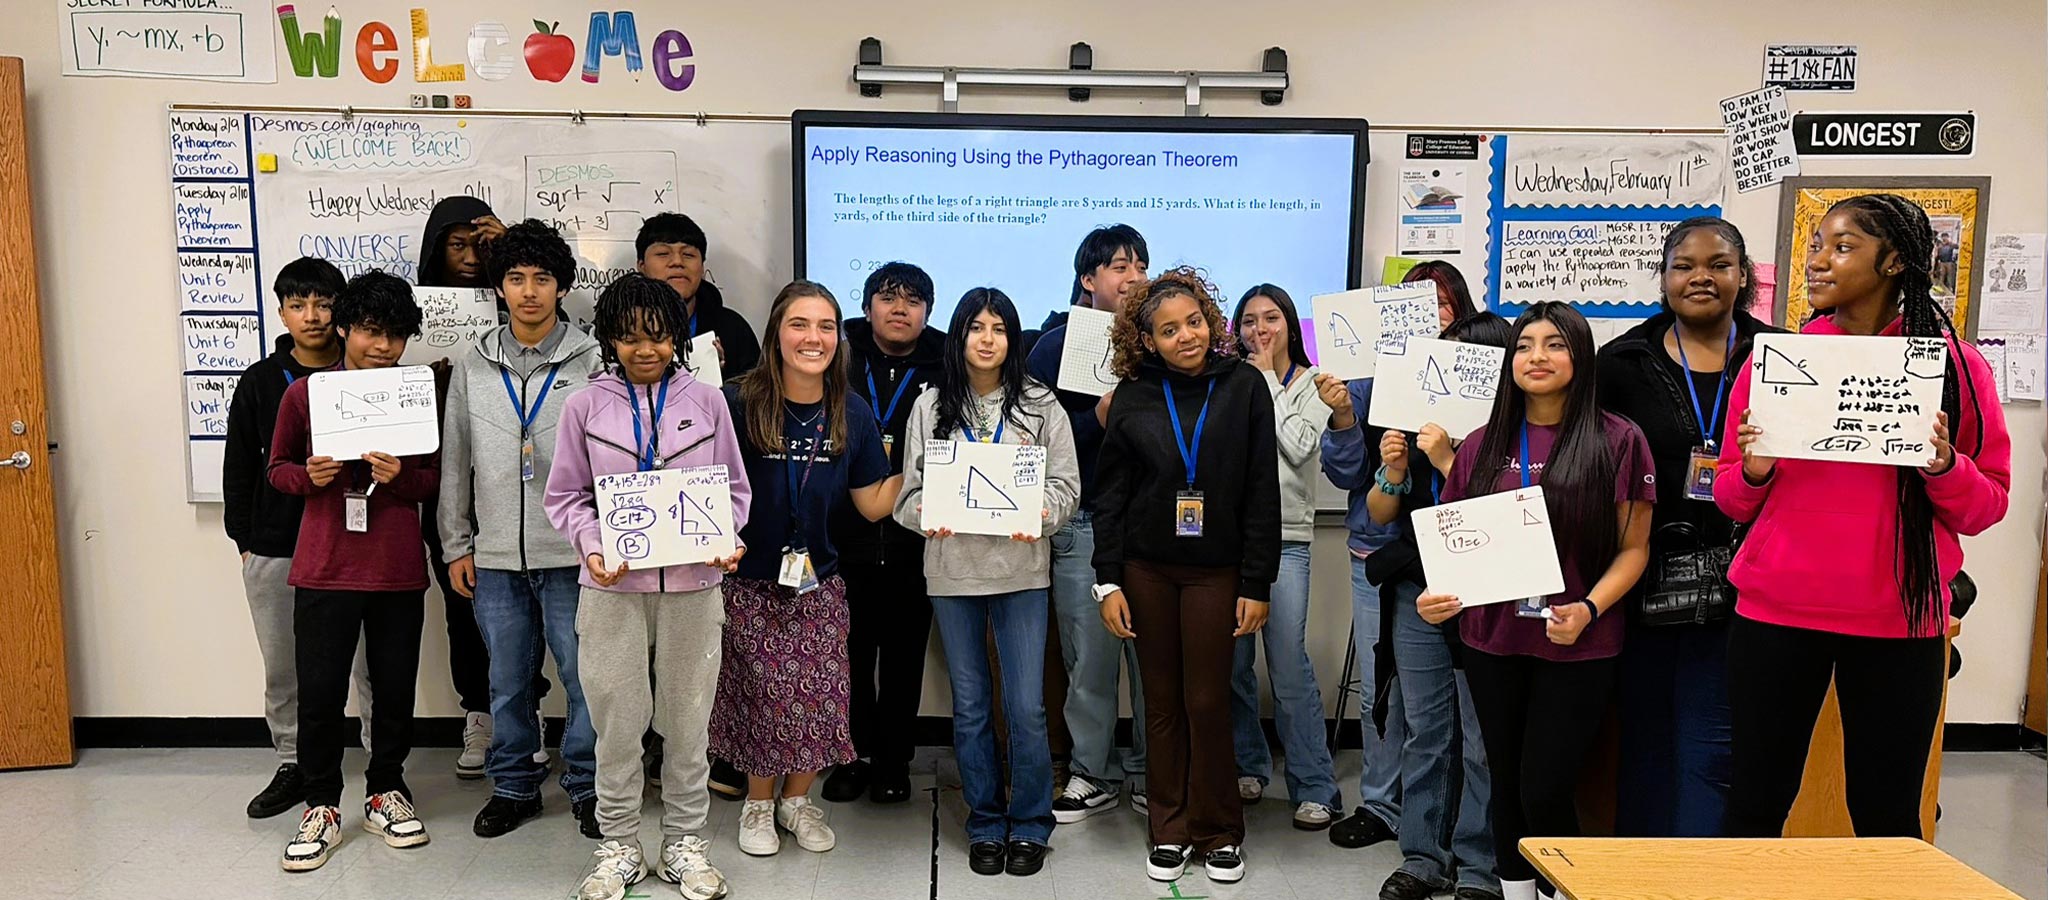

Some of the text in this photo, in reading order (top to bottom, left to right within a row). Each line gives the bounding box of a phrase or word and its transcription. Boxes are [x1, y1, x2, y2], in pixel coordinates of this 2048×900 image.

[1768, 57, 1800, 80] #1
[1822, 57, 1856, 80] FAN
[1740, 94, 1762, 107] FAM.
[1764, 87, 1782, 100] IT'S
[1724, 102, 1770, 124] LOW KEY
[1748, 112, 1778, 129] WHEN
[1780, 109, 1787, 119] U
[171, 116, 240, 138] Monday 2/9
[252, 116, 421, 139] Desmos.com/graphing
[1760, 120, 1790, 138] SHOW
[1811, 122, 1921, 147] LONGEST
[172, 133, 237, 153] Pythagorean
[304, 137, 460, 161] WELCOME BACK!
[1747, 135, 1780, 152] WORK.
[811, 145, 1238, 170] Apply Reasoning Using the Pythagorean Theorem
[1733, 148, 1777, 168] NO CAP.
[1735, 156, 1793, 179] DO BETTER.
[173, 160, 239, 176] (Distance)
[538, 163, 614, 184] DESMOS
[1515, 163, 1612, 195] Wednesday,
[1611, 159, 1671, 199] February
[1738, 172, 1776, 190] BESTIE.
[175, 184, 249, 206] Tuesday 2/10
[308, 187, 361, 222] Happy
[537, 184, 588, 212] sqrt
[834, 192, 856, 204] The
[859, 193, 900, 206] lengths
[902, 194, 914, 205] of
[917, 195, 934, 206] the
[937, 195, 958, 207] legs
[961, 195, 974, 206] of
[975, 198, 982, 206] a
[985, 196, 1012, 208] right
[1015, 197, 1059, 208] triangle
[1061, 200, 1080, 208] are
[1091, 198, 1123, 210] yards
[1126, 198, 1147, 209] and
[1151, 198, 1163, 209] 15
[1166, 198, 1200, 210] yards.
[1203, 198, 1234, 209] What
[1237, 199, 1246, 210] is
[1249, 199, 1267, 210] the
[1269, 199, 1308, 212] length,
[1311, 199, 1321, 210] in
[177, 202, 212, 223] Apply
[834, 211, 1047, 225] yards, of the third side of the triangle?
[178, 216, 242, 235] Pythagorean
[1506, 223, 1567, 246] Learning
[1606, 222, 1637, 233] MGSR
[180, 234, 231, 246] Theorem
[299, 233, 413, 263] CONVERSE
[1608, 234, 1637, 246] MGSR
[1504, 246, 1663, 260] I can use repeated reasonin
[180, 254, 252, 274] Wednesday 2/11
[1505, 260, 1536, 277] apply
[1543, 259, 1560, 272] the
[1565, 258, 1630, 283] Pythagorean
[182, 272, 227, 287] Unit 6
[1505, 273, 1628, 291] a variety of problems
[188, 288, 244, 304] Review
[186, 317, 239, 339] Thursday
[188, 334, 236, 349] Unit 6
[197, 352, 251, 368] Review
[190, 399, 220, 420] Unit
[200, 417, 229, 433] Tes
[668, 504, 678, 519] 8
